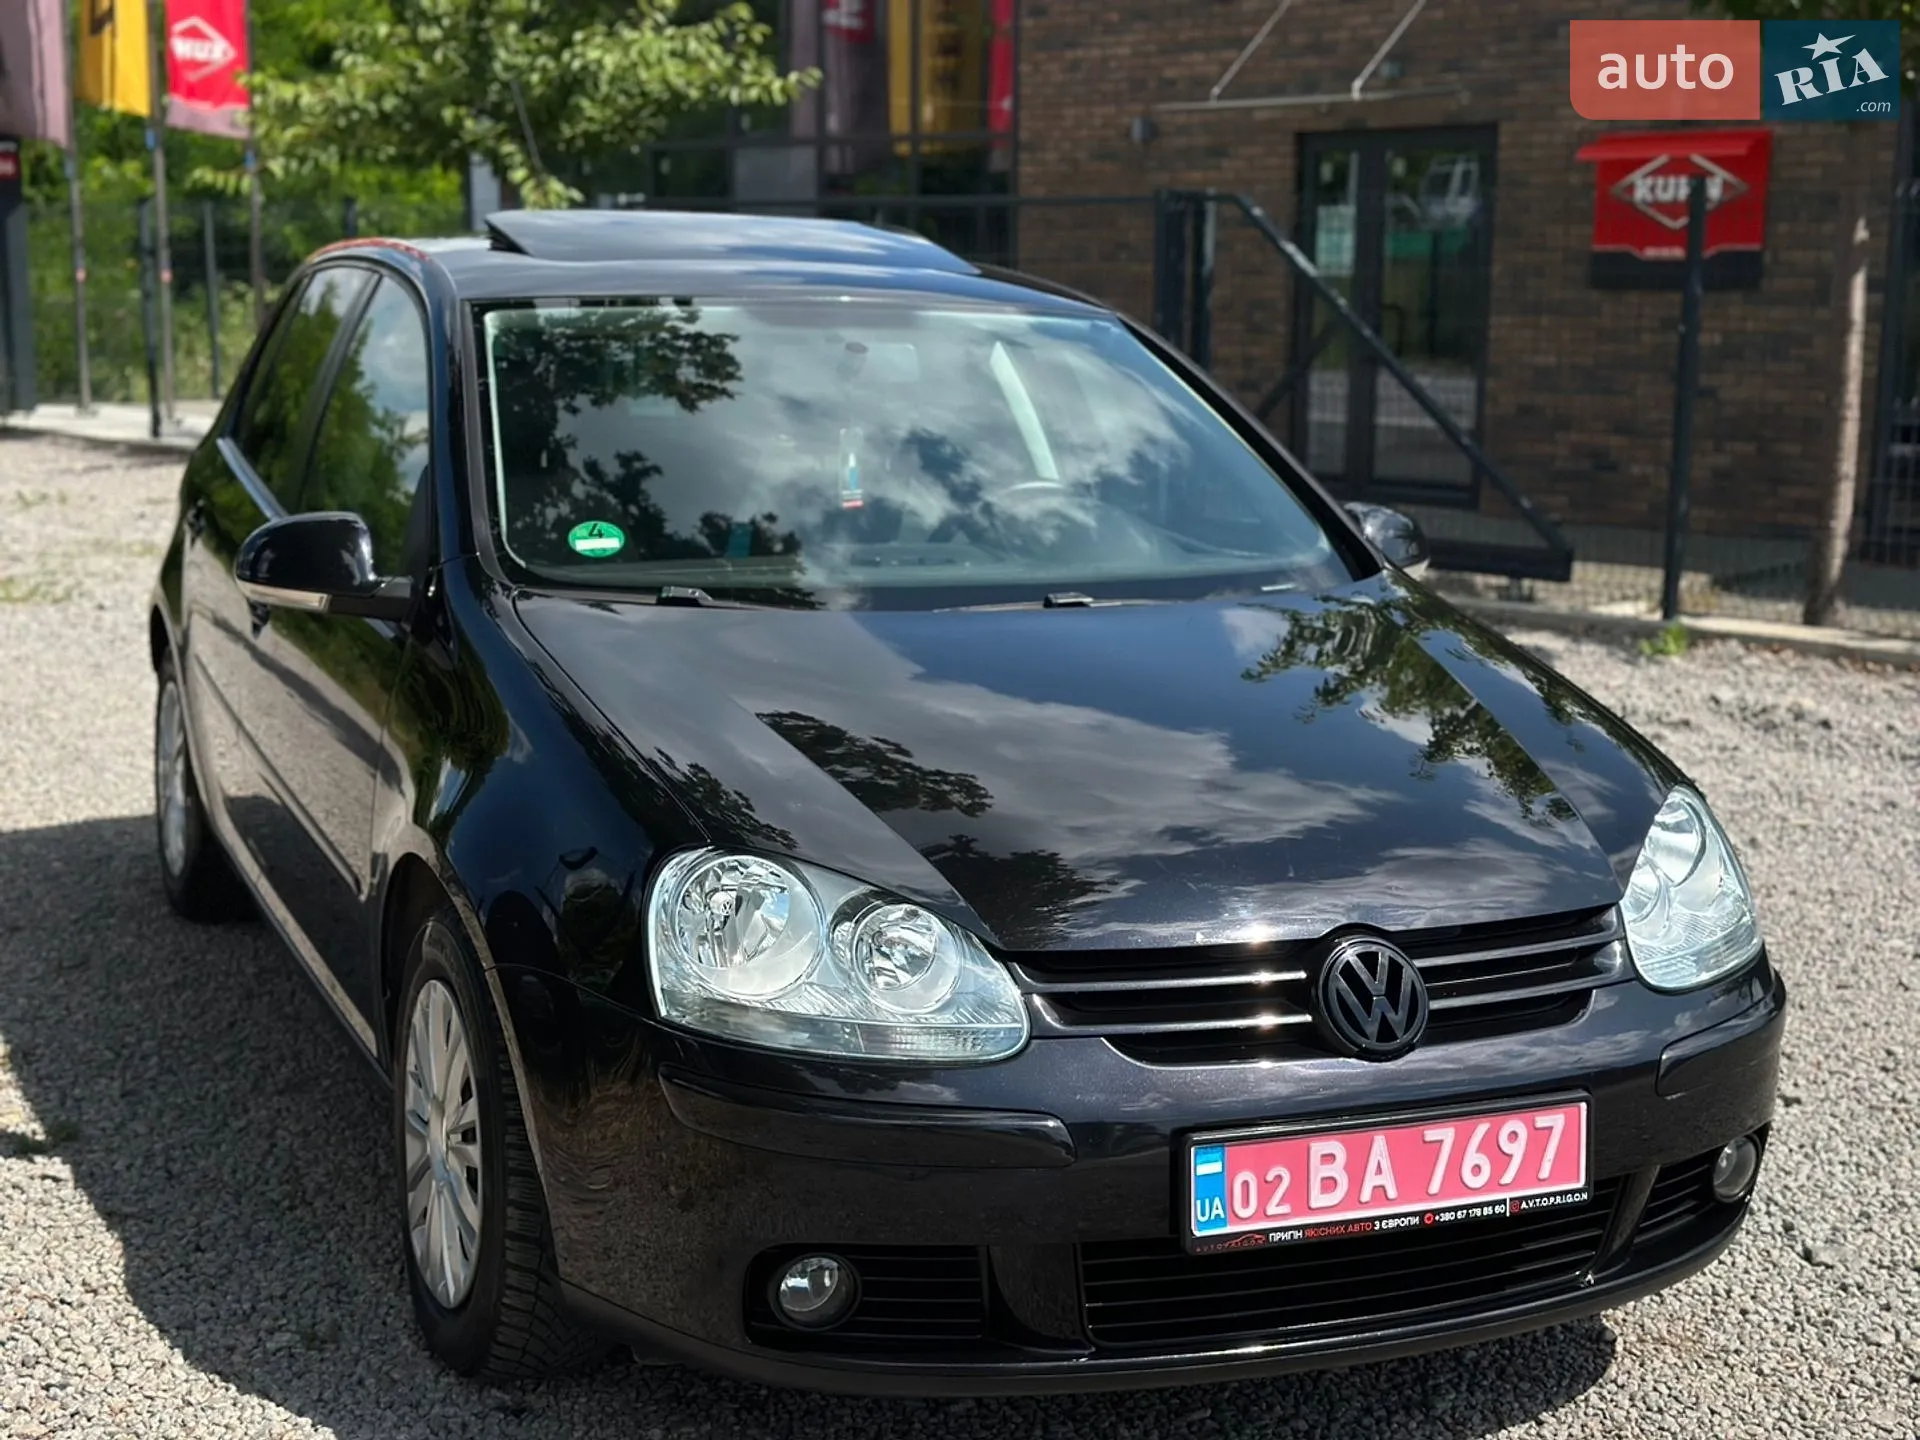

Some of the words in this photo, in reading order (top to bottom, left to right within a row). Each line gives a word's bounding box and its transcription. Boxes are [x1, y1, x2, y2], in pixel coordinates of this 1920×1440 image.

[588, 523, 604, 538] 4
[1232, 1166, 1292, 1219] 02
[1308, 1134, 1398, 1209] BA
[1423, 1113, 1565, 1196] 7697
[1196, 1196, 1225, 1222] UA
